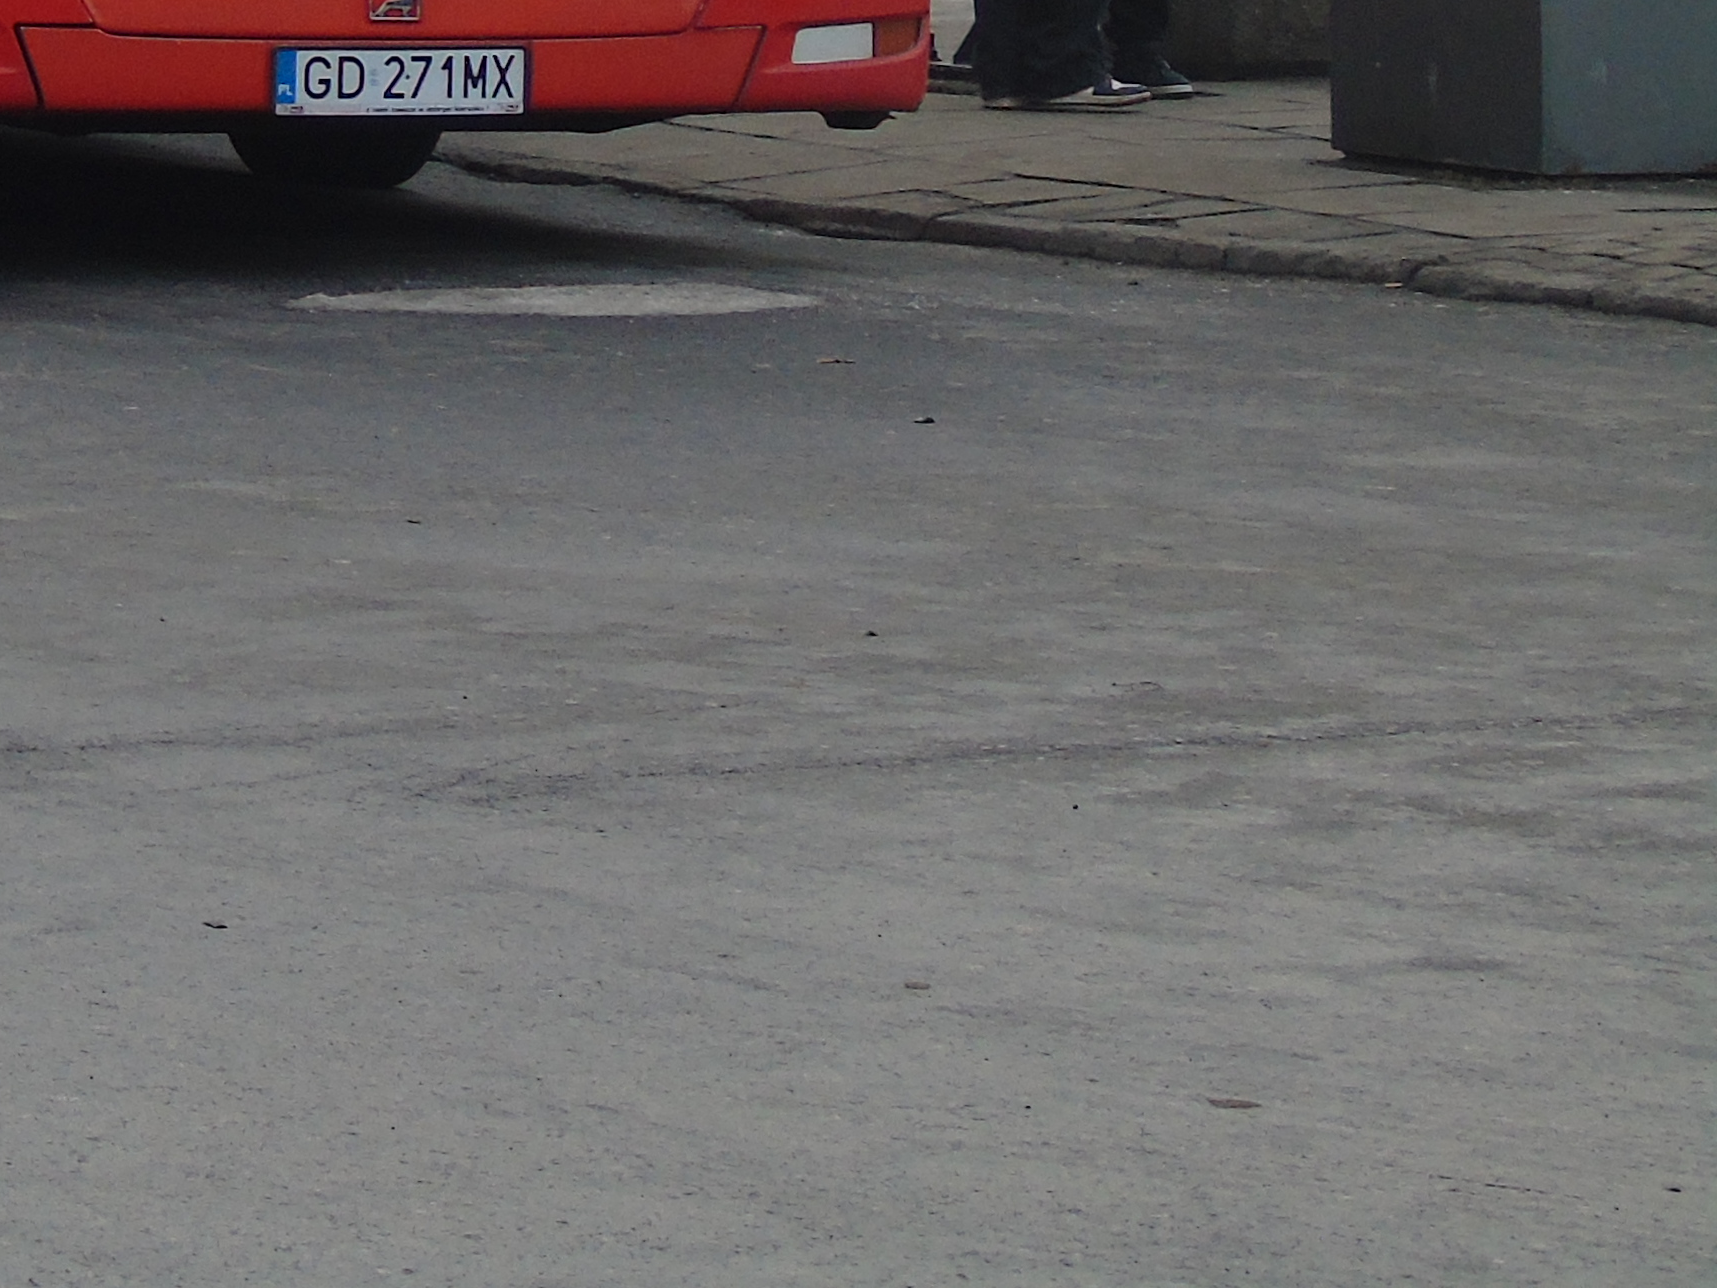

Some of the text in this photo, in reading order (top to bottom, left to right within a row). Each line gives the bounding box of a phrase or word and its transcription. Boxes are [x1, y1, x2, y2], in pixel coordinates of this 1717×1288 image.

[277, 84, 293, 96] PL
[303, 54, 515, 100] GD 271MX
